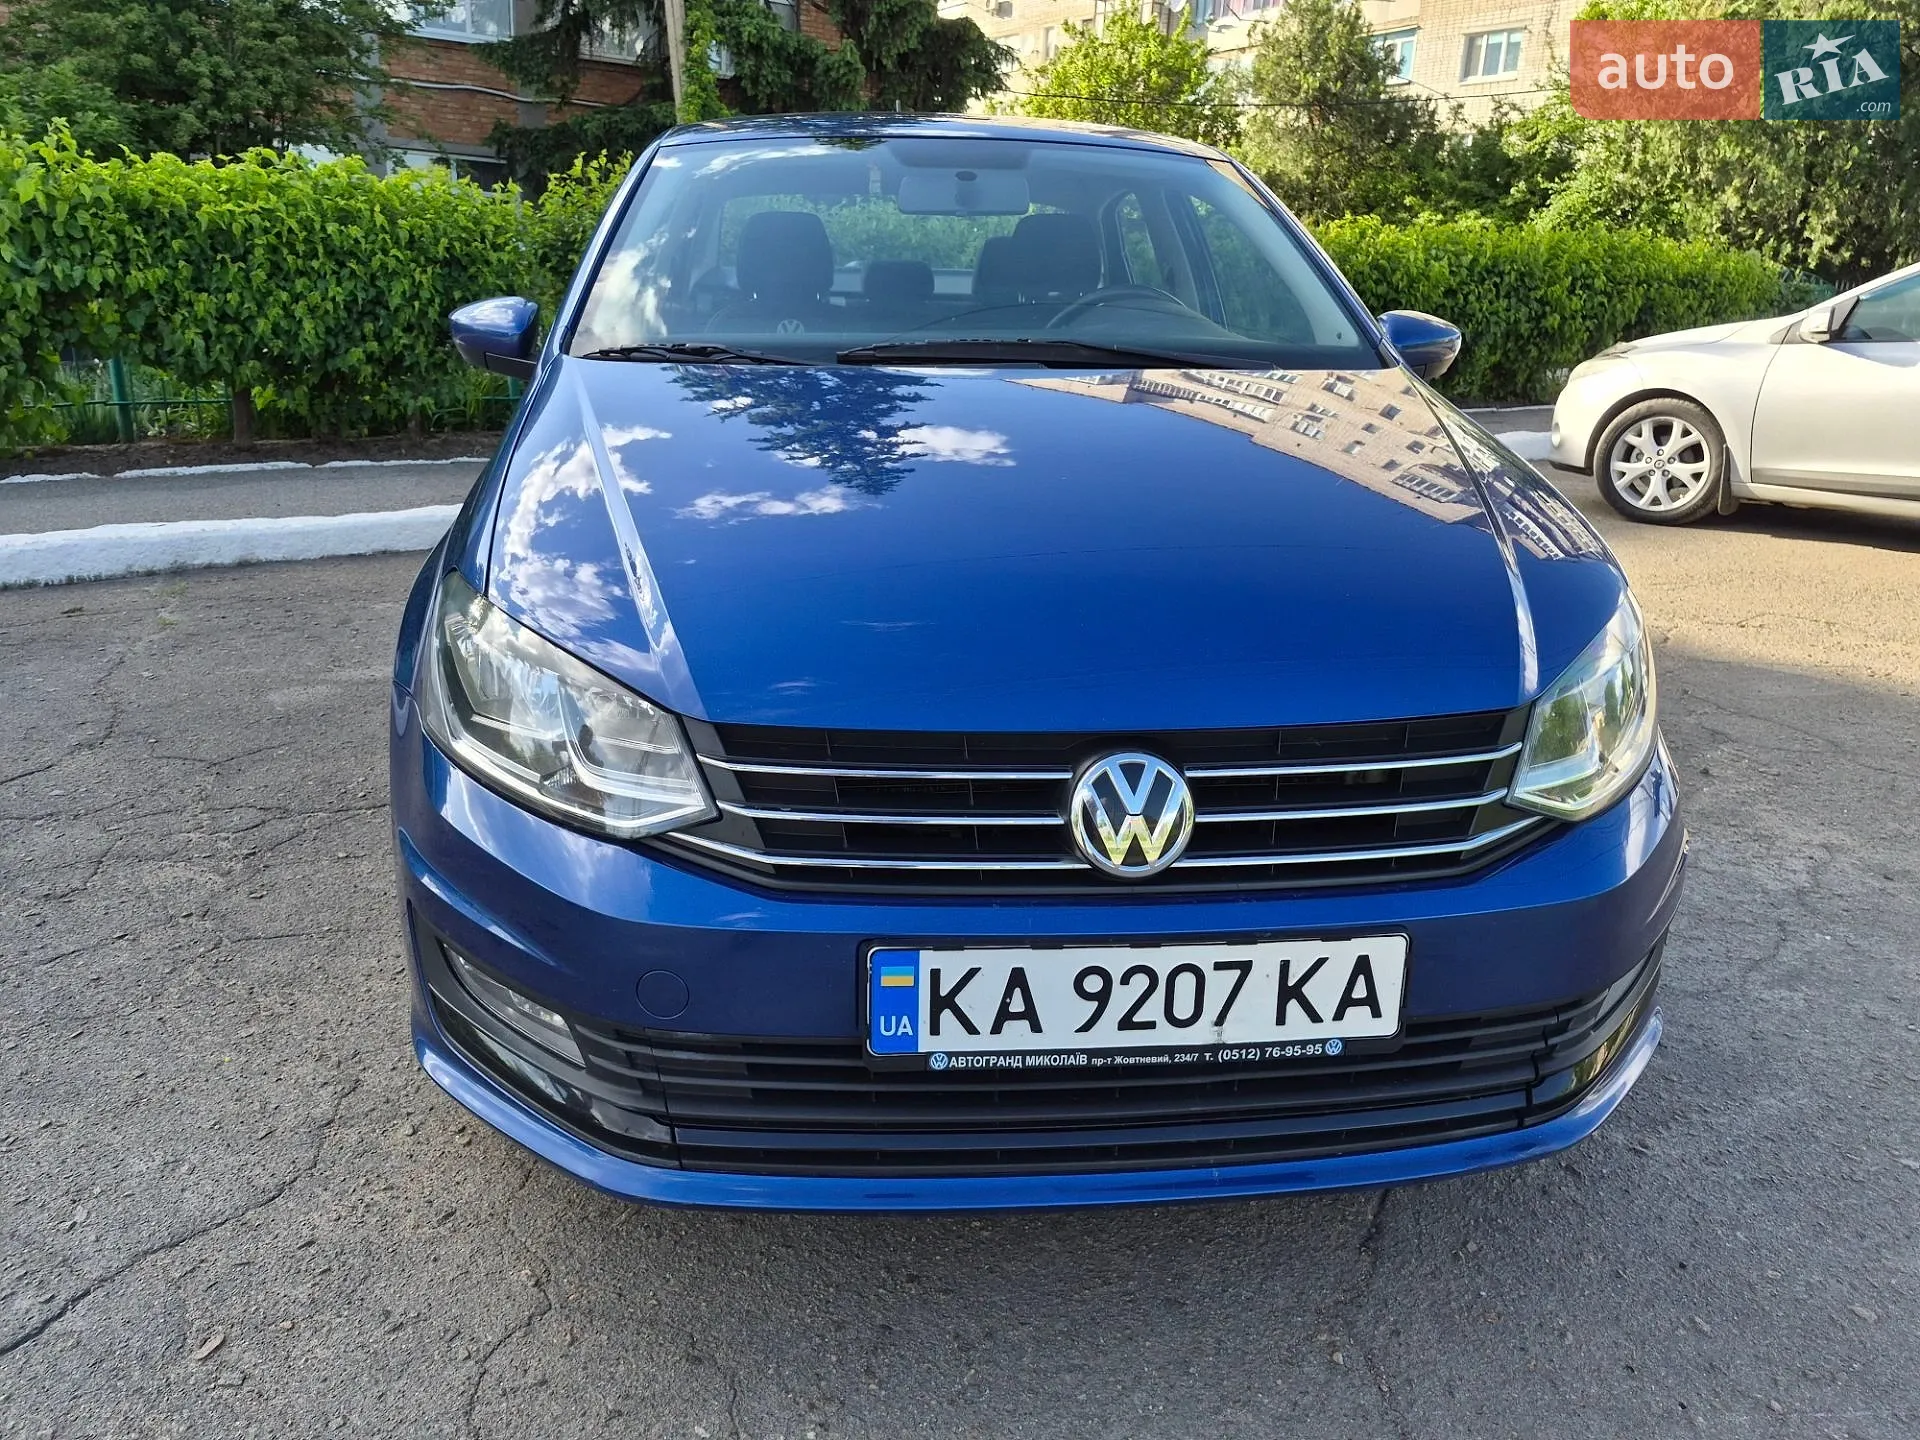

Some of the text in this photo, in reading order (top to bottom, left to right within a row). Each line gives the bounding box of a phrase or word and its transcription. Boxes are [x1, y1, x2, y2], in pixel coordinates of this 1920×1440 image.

[1073, 960, 1254, 1033] 9207
[879, 1015, 914, 1036] UA
[950, 1056, 1022, 1068] АВТОГРАНД
[1025, 1052, 1088, 1066] МИКОЛАЇВ
[1174, 1053, 1199, 1063] 234/7
[1218, 1048, 1260, 1063] (0512)
[1264, 1043, 1322, 1058] 76-95-95
